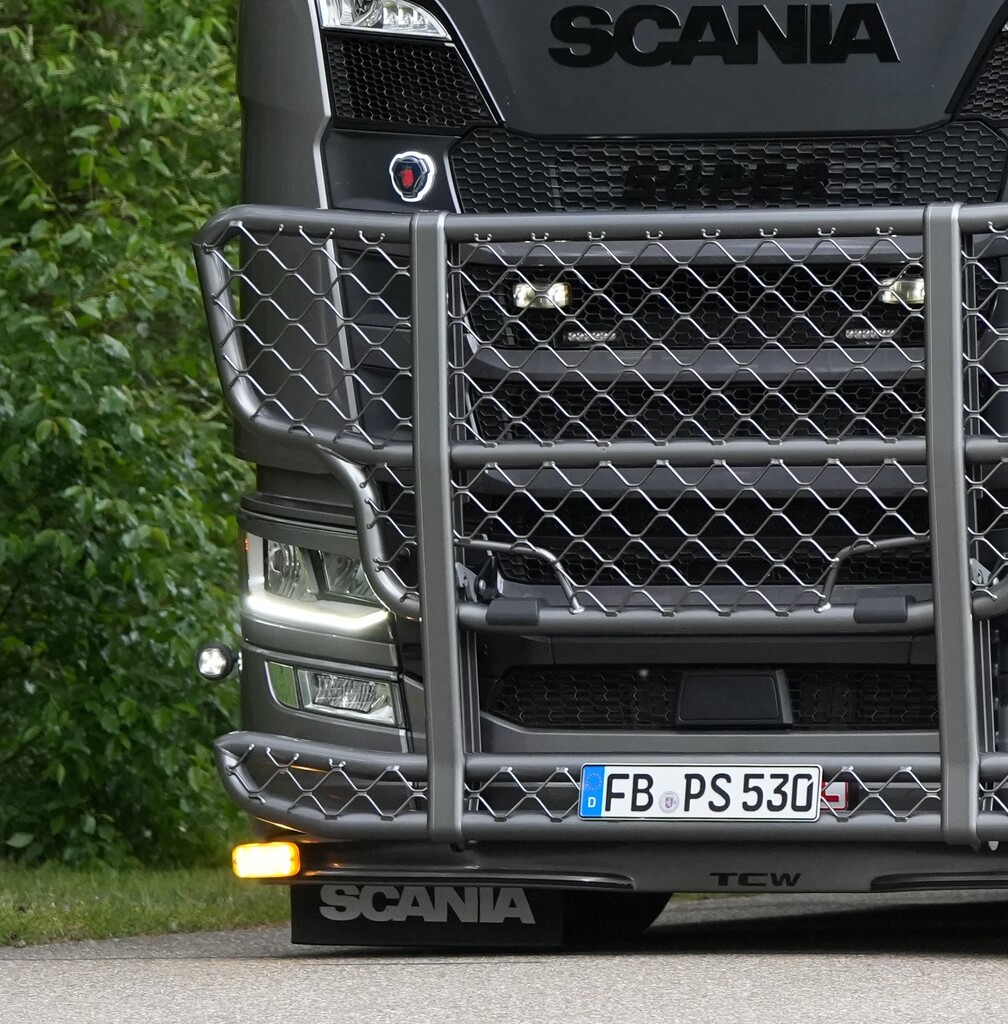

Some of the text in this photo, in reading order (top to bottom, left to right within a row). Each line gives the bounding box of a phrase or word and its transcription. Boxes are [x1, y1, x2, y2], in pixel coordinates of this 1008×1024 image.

[548, 3, 901, 68] SCANIA
[587, 797, 597, 808] D
[604, 773, 654, 812] FB
[710, 872, 802, 887] TCW
[319, 884, 536, 924] SCANIA
